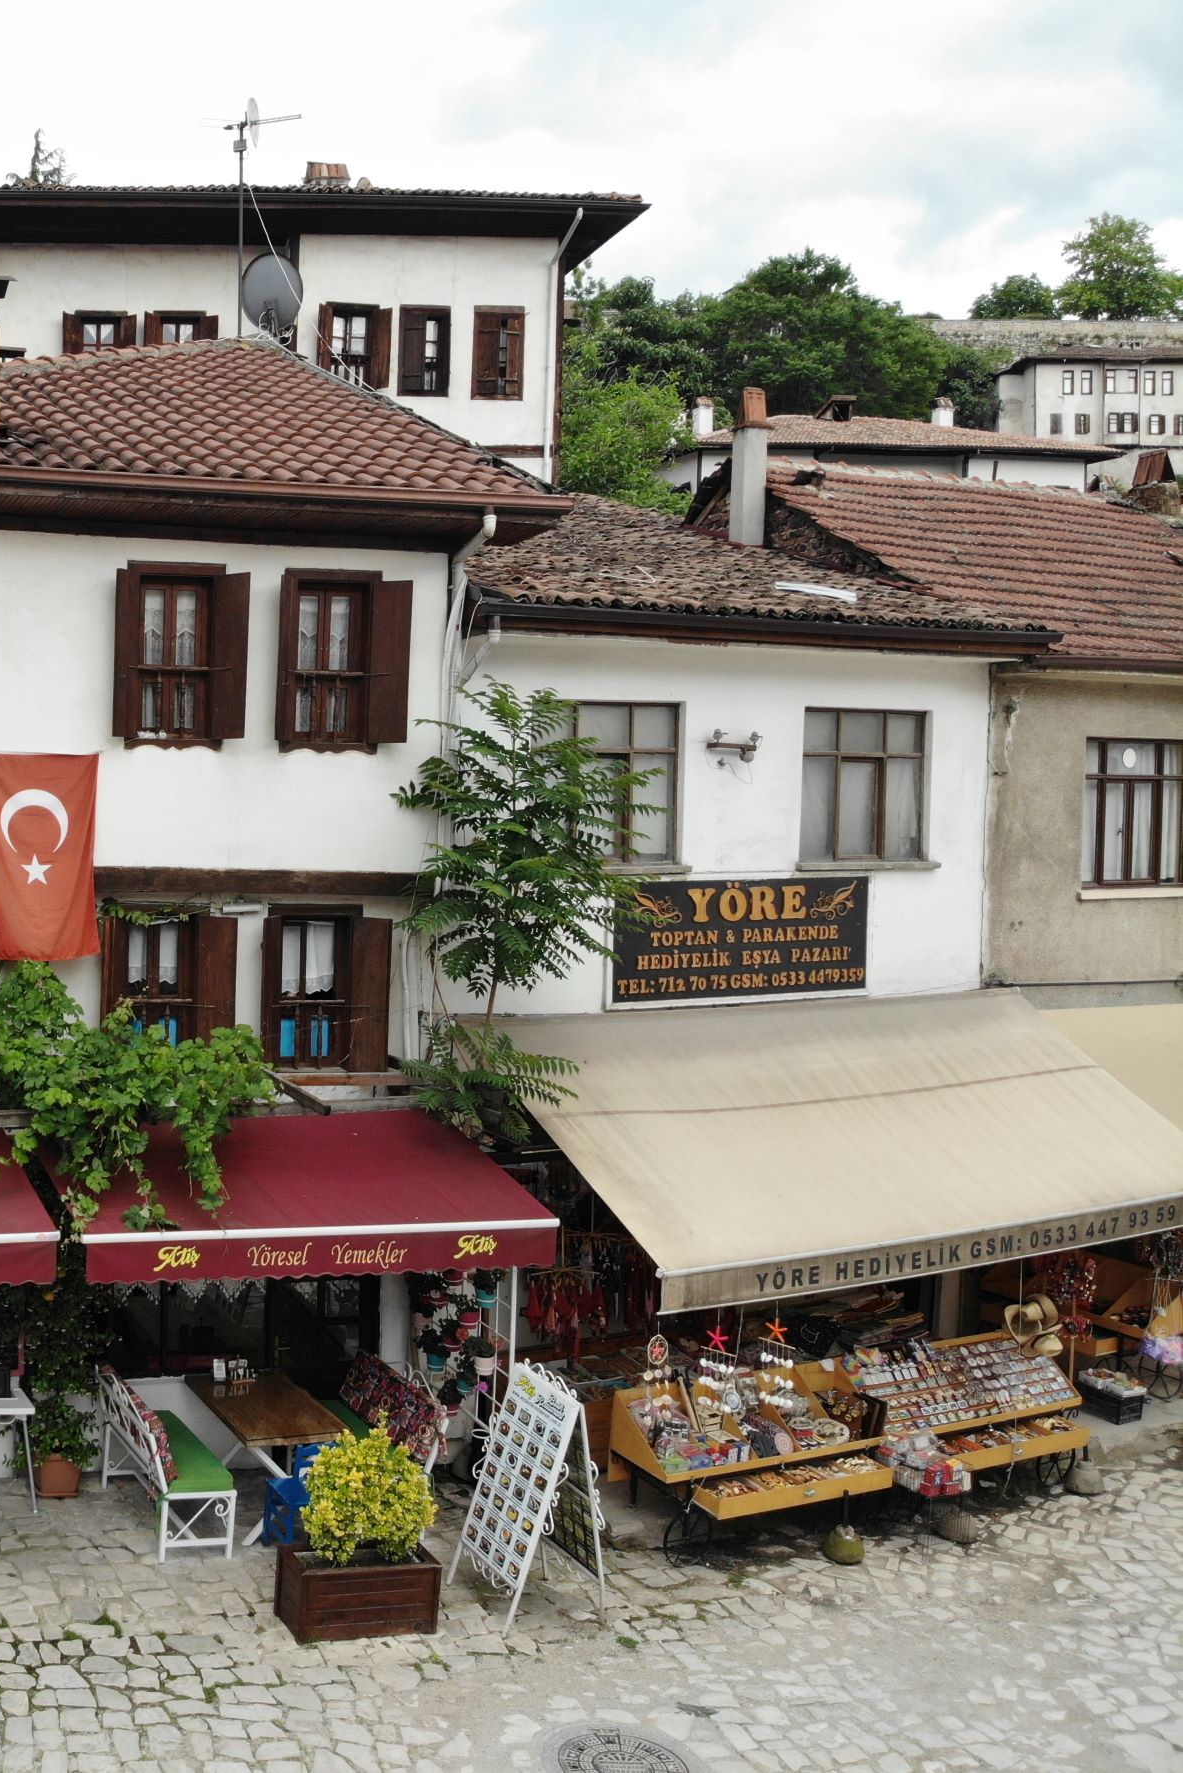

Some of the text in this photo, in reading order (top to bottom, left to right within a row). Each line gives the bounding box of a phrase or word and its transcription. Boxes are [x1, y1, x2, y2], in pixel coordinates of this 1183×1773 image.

[687, 881, 808, 923] YÖRE
[650, 924, 839, 947] TOPTAN & PARAKENDE
[636, 948, 732, 970] HEDİYELİK
[741, 949, 782, 969] EŞYA
[617, 967, 865, 995] TEL: 712 70 75 GSM: 0533 4479359
[247, 1240, 409, 1269] Yöresel Yemekler
[755, 1204, 1176, 1293] YÖRE HEDİYELİK GSM: 0533 447 93 59
